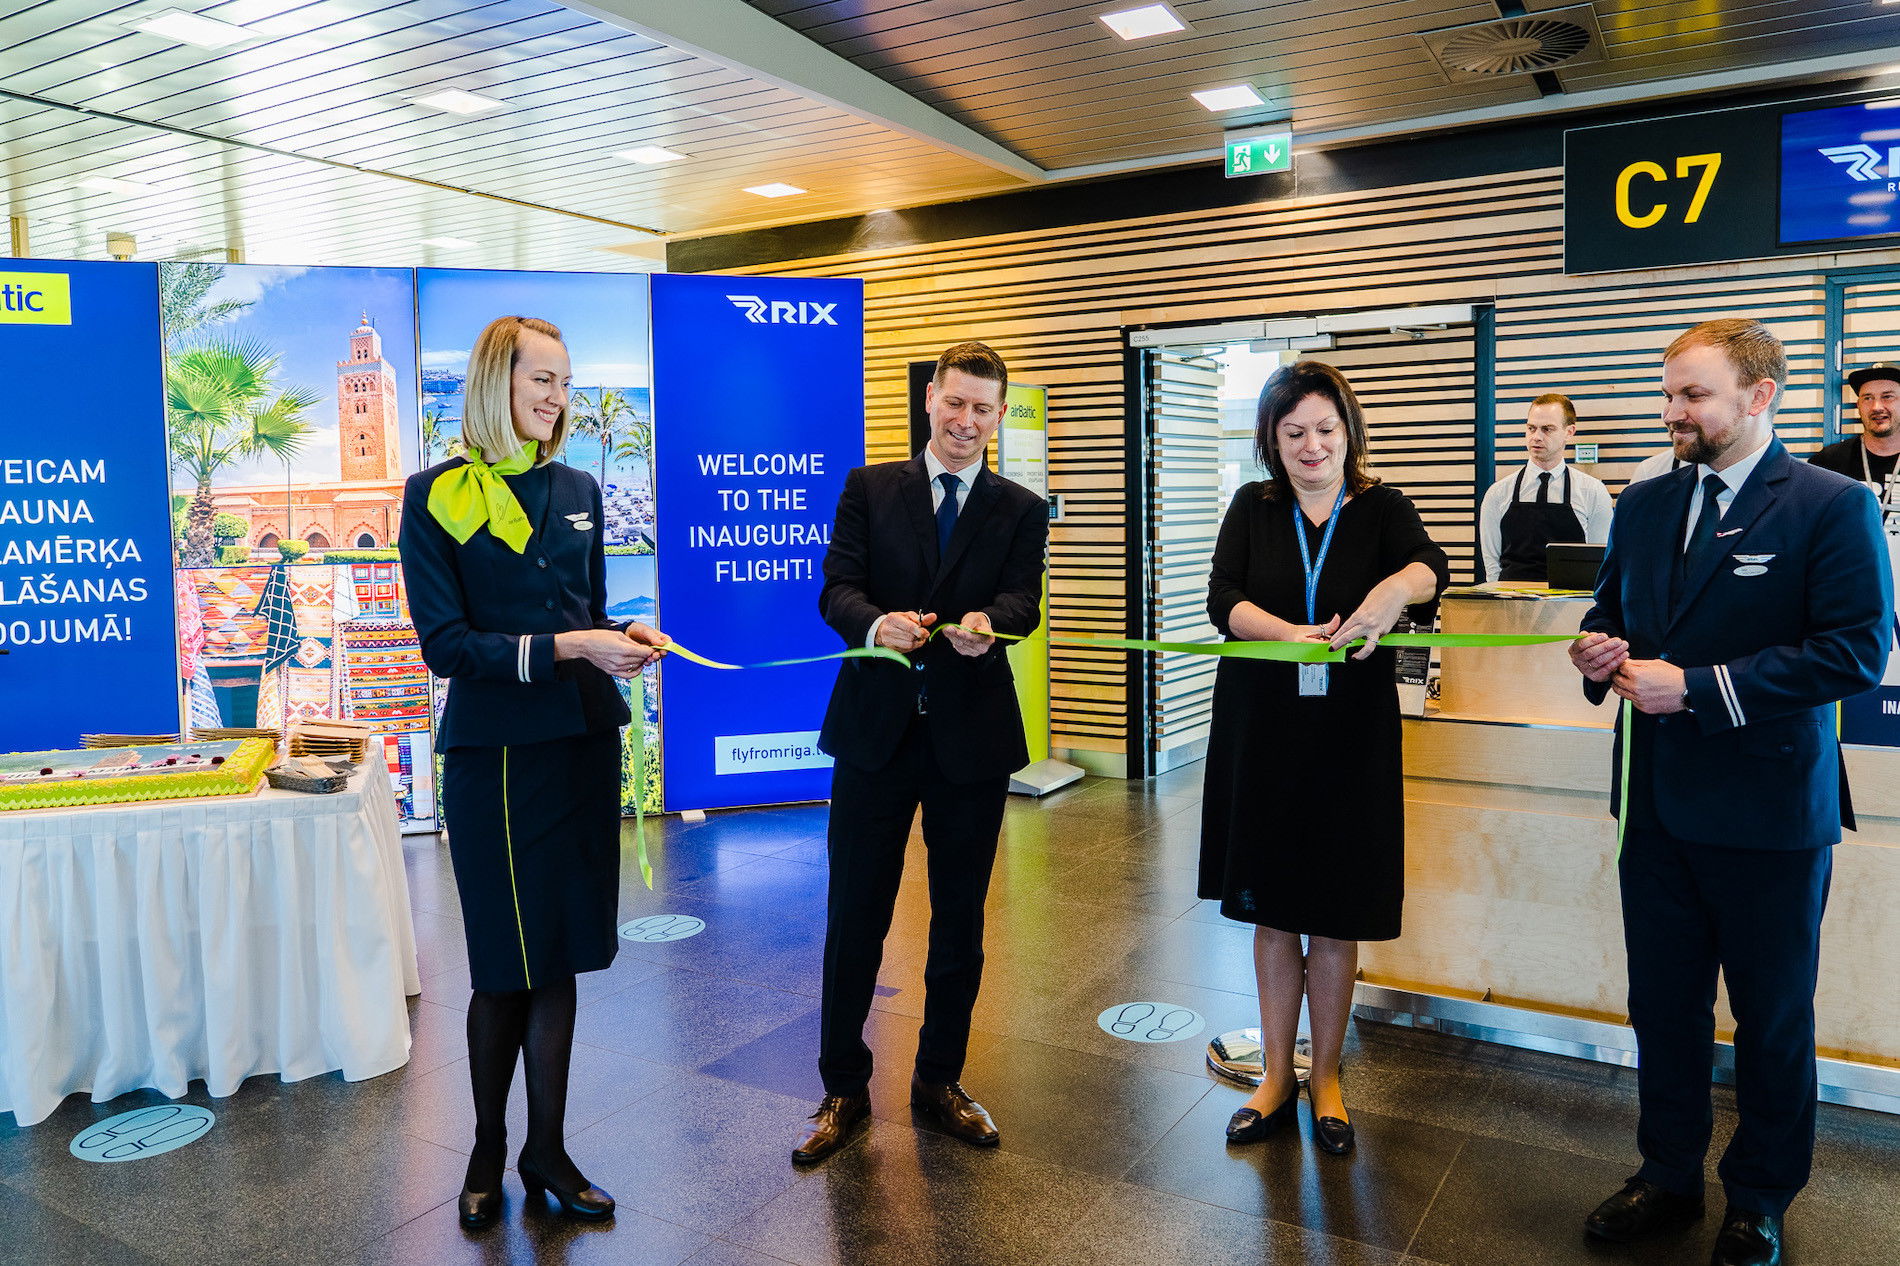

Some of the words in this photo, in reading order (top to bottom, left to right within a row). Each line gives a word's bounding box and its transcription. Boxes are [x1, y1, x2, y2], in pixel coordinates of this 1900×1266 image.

[1615, 152, 1722, 229] C7
[0, 284, 44, 312] tic
[770, 300, 839, 326] RIX
[1010, 404, 1036, 419] airBaltic
[0, 459, 106, 484] EICAM
[697, 453, 825, 476] WELCOME
[717, 489, 750, 511] TO
[757, 488, 807, 511] THE
[689, 523, 831, 548] INAUGURAL
[0, 535, 143, 569] AMĒRĶA
[715, 558, 813, 583] FLIGHT!
